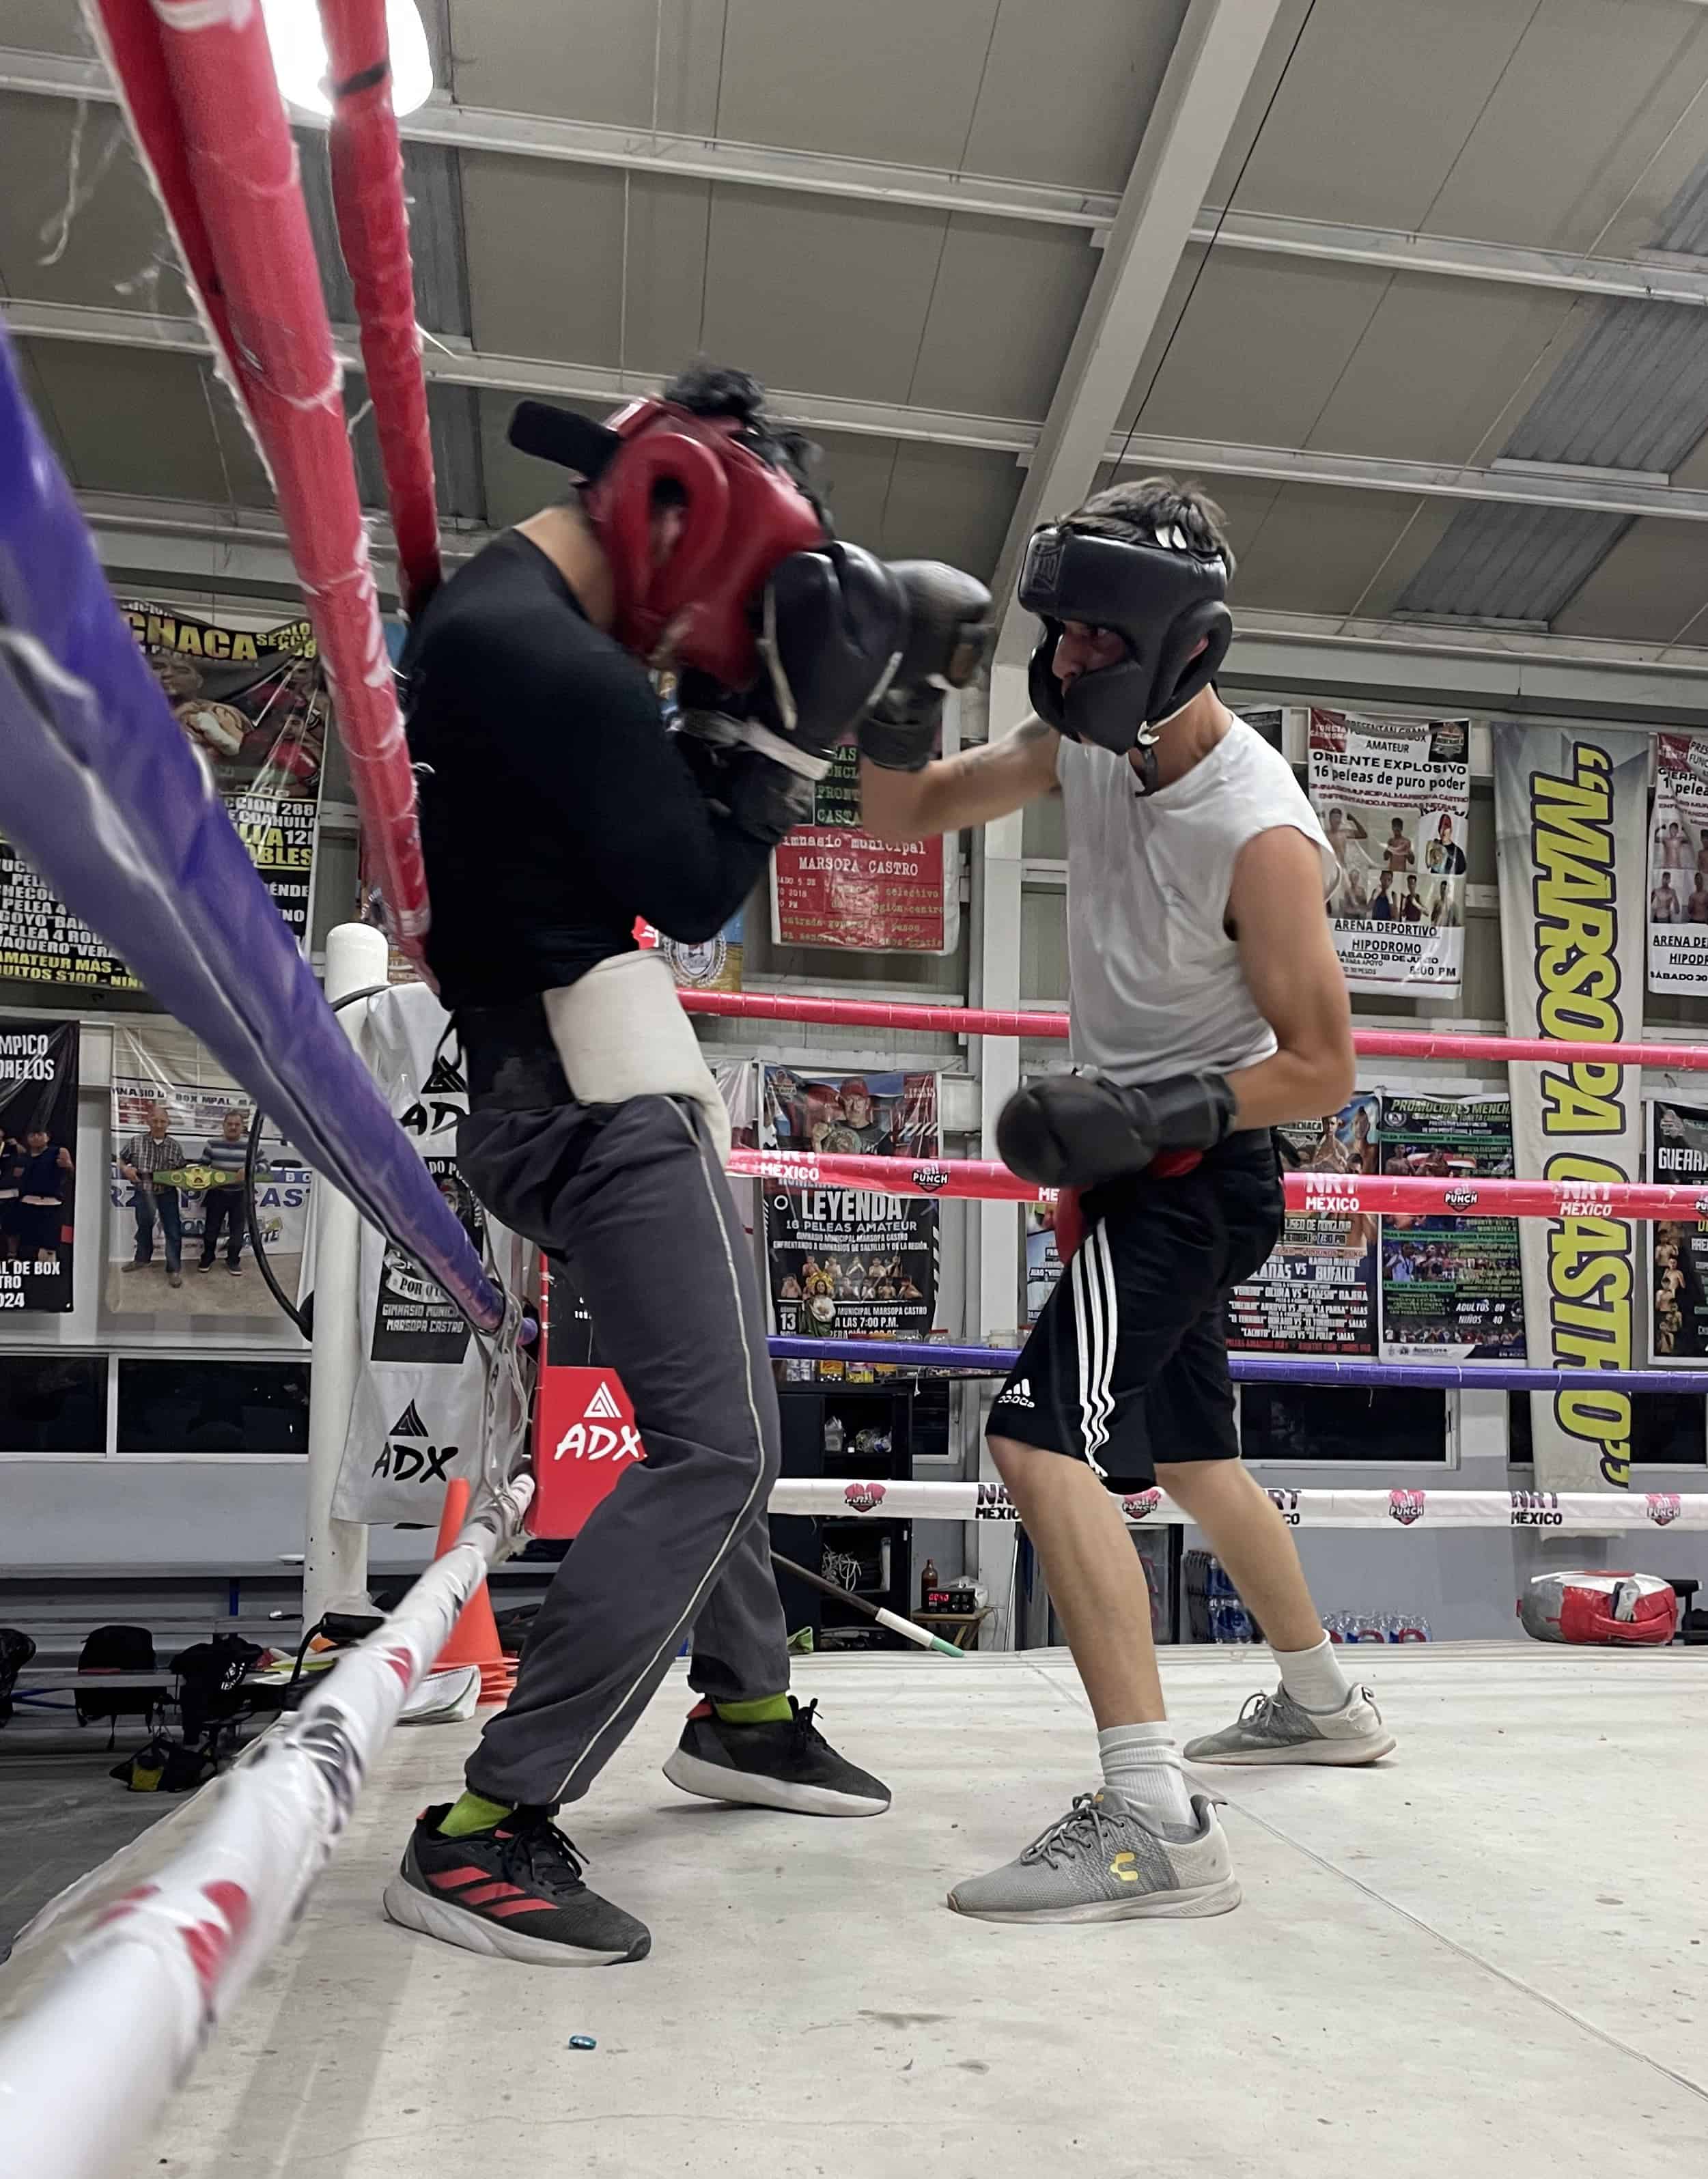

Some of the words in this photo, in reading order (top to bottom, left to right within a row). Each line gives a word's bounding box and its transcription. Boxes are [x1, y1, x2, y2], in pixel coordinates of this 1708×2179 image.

[1366, 740, 1410, 754] AMATEUR
[1313, 751, 1381, 768] ORIENTE
[1384, 759, 1466, 775] EXPLOSIVO
[1314, 765, 1329, 777] 16
[1332, 768, 1374, 783] peleas
[1377, 771, 1393, 785] de
[1396, 776, 1425, 790] puro
[1429, 776, 1466, 791] poder
[281, 802, 314, 816] 288
[284, 830, 313, 845] 12
[798, 856, 860, 873] MARSOPA
[868, 860, 919, 877] CASTRO
[3, 897, 53, 914] PELEA
[53, 929, 64, 942] 4
[1334, 919, 1373, 932] ARENA
[1377, 922, 1438, 938] DEPORTIVO
[1352, 939, 1422, 954] HIPODROMO
[1653, 934, 1690, 947] ARENA
[75, 958, 112, 974] MÁS
[1438, 967, 1456, 977] PM
[913, 1172, 948, 1183] PUNCH
[801, 1190, 903, 1222] LEYENDA
[1305, 1194, 1360, 1211] MÉXICO
[1445, 1192, 1479, 1205] PUNCH
[1560, 1200, 1612, 1217] MÉXICO
[804, 1220, 852, 1233] PELEAS
[856, 1220, 917, 1233] AMATEUR
[13, 1261, 31, 1275] DE
[33, 1261, 61, 1275] BOX
[1295, 1263, 1307, 1276] VS
[400, 1277, 423, 1296] POR
[1291, 1289, 1302, 1299] VS
[1287, 1303, 1296, 1312] VS
[1455, 1301, 1490, 1312] ADULTOS
[780, 1313, 796, 1331] 13
[873, 1306, 904, 1316] MARSOPA
[904, 1306, 927, 1315] CASTRO
[835, 1317, 841, 1328] A
[842, 1317, 858, 1328] LAS
[859, 1317, 879, 1329] 7:00
[880, 1317, 899, 1328] P.M.
[553, 1422, 642, 1461] ADX
[371, 1442, 459, 1483] ADX
[1388, 1506, 1424, 1516] PUNCH
[1510, 1509, 1563, 1526] MÉXICO
